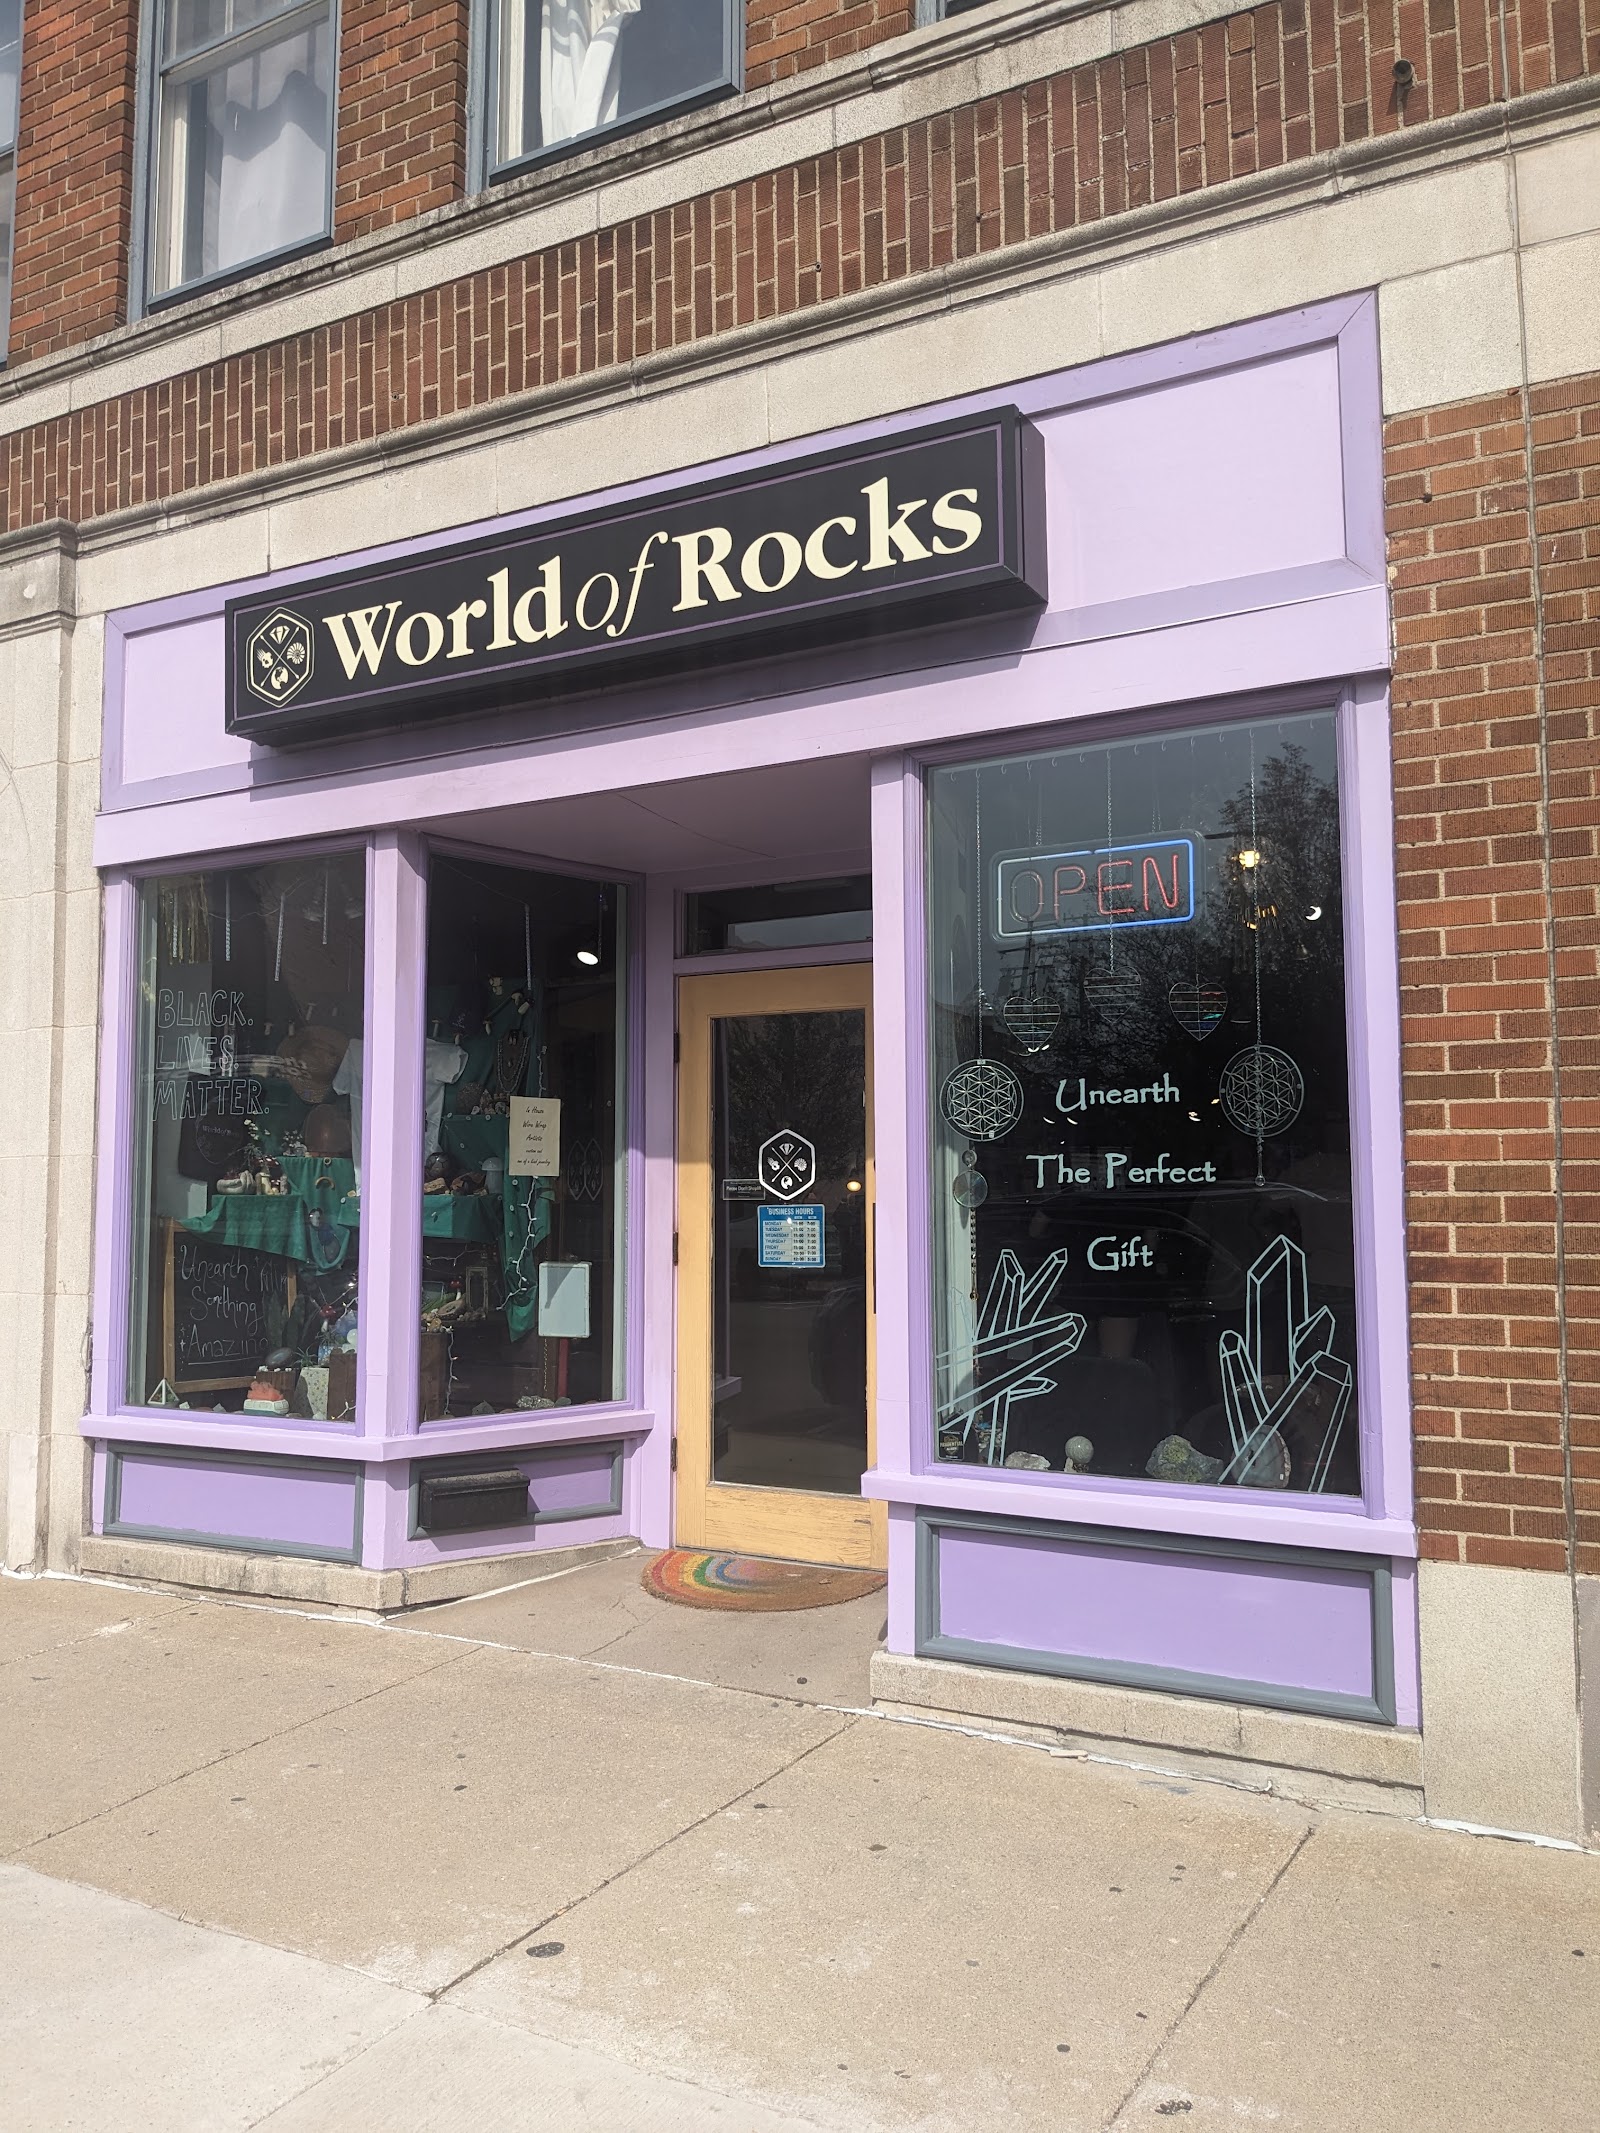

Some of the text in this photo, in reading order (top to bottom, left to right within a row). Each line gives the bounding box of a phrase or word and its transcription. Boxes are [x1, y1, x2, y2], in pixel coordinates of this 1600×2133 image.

[322, 477, 984, 680] World of Rocks
[1009, 853, 1181, 923] OPEN
[157, 988, 254, 1029] BLACK.
[155, 1035, 240, 1071] LIVES.
[152, 1079, 270, 1122] MATTER.
[1056, 1073, 1180, 1112] Unearth
[1026, 1153, 1217, 1188] The Perfect
[181, 1244, 250, 1294] Unearth
[1087, 1236, 1153, 1271] Gift
